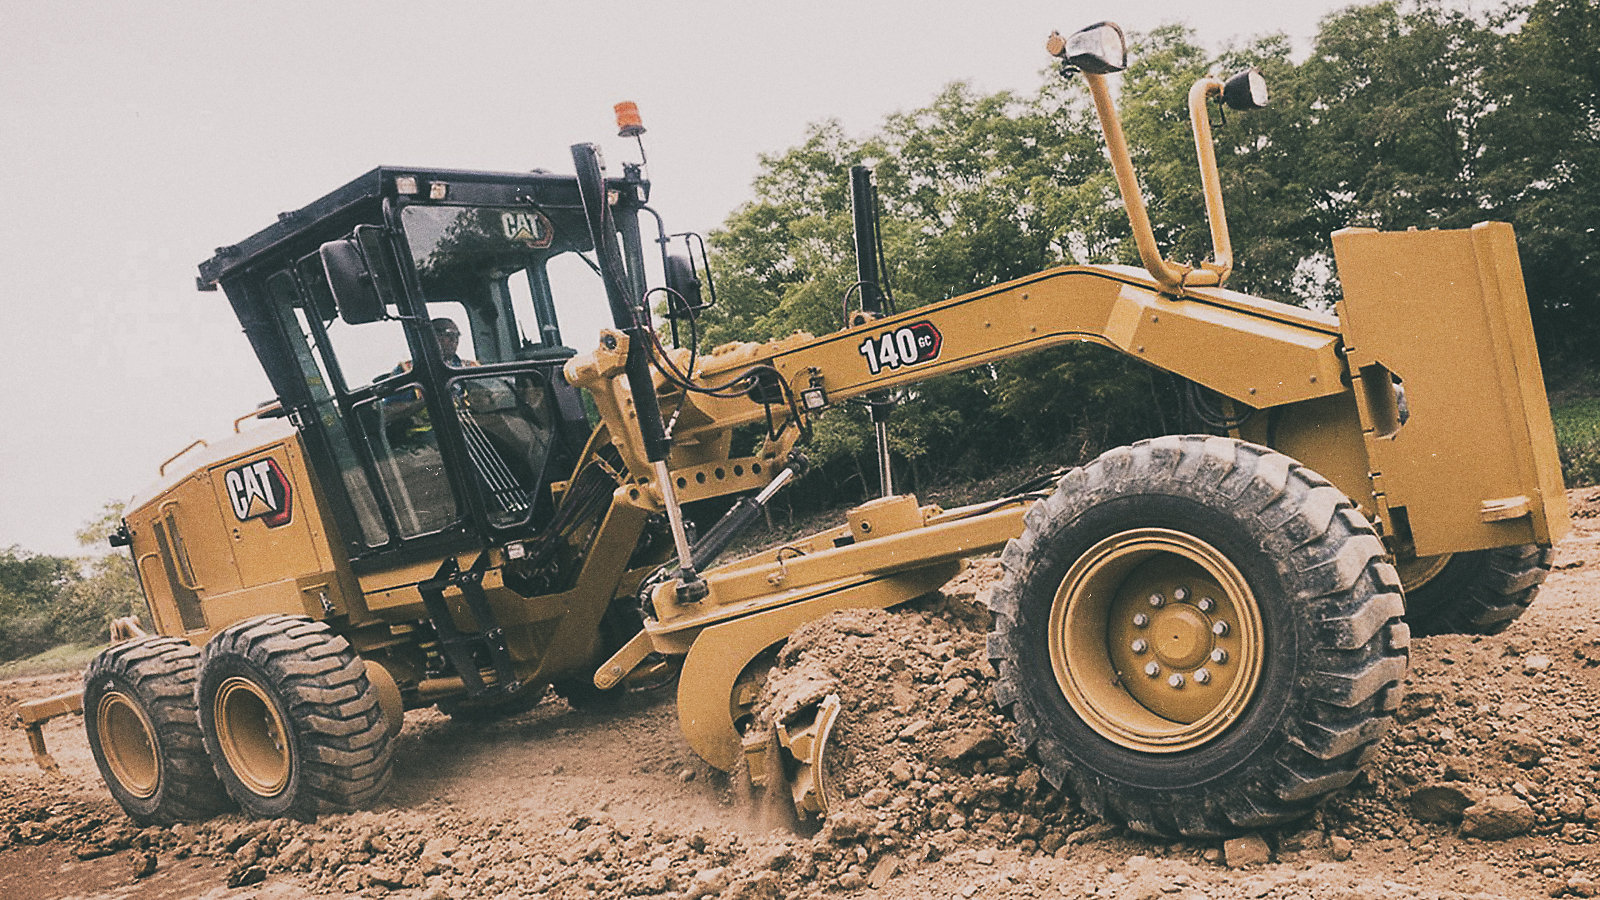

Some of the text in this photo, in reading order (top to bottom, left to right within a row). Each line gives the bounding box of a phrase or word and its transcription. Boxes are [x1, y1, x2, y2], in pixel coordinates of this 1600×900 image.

[501, 212, 538, 239] CAT
[860, 328, 932, 372] 140 GC
[226, 460, 277, 519] CAT
